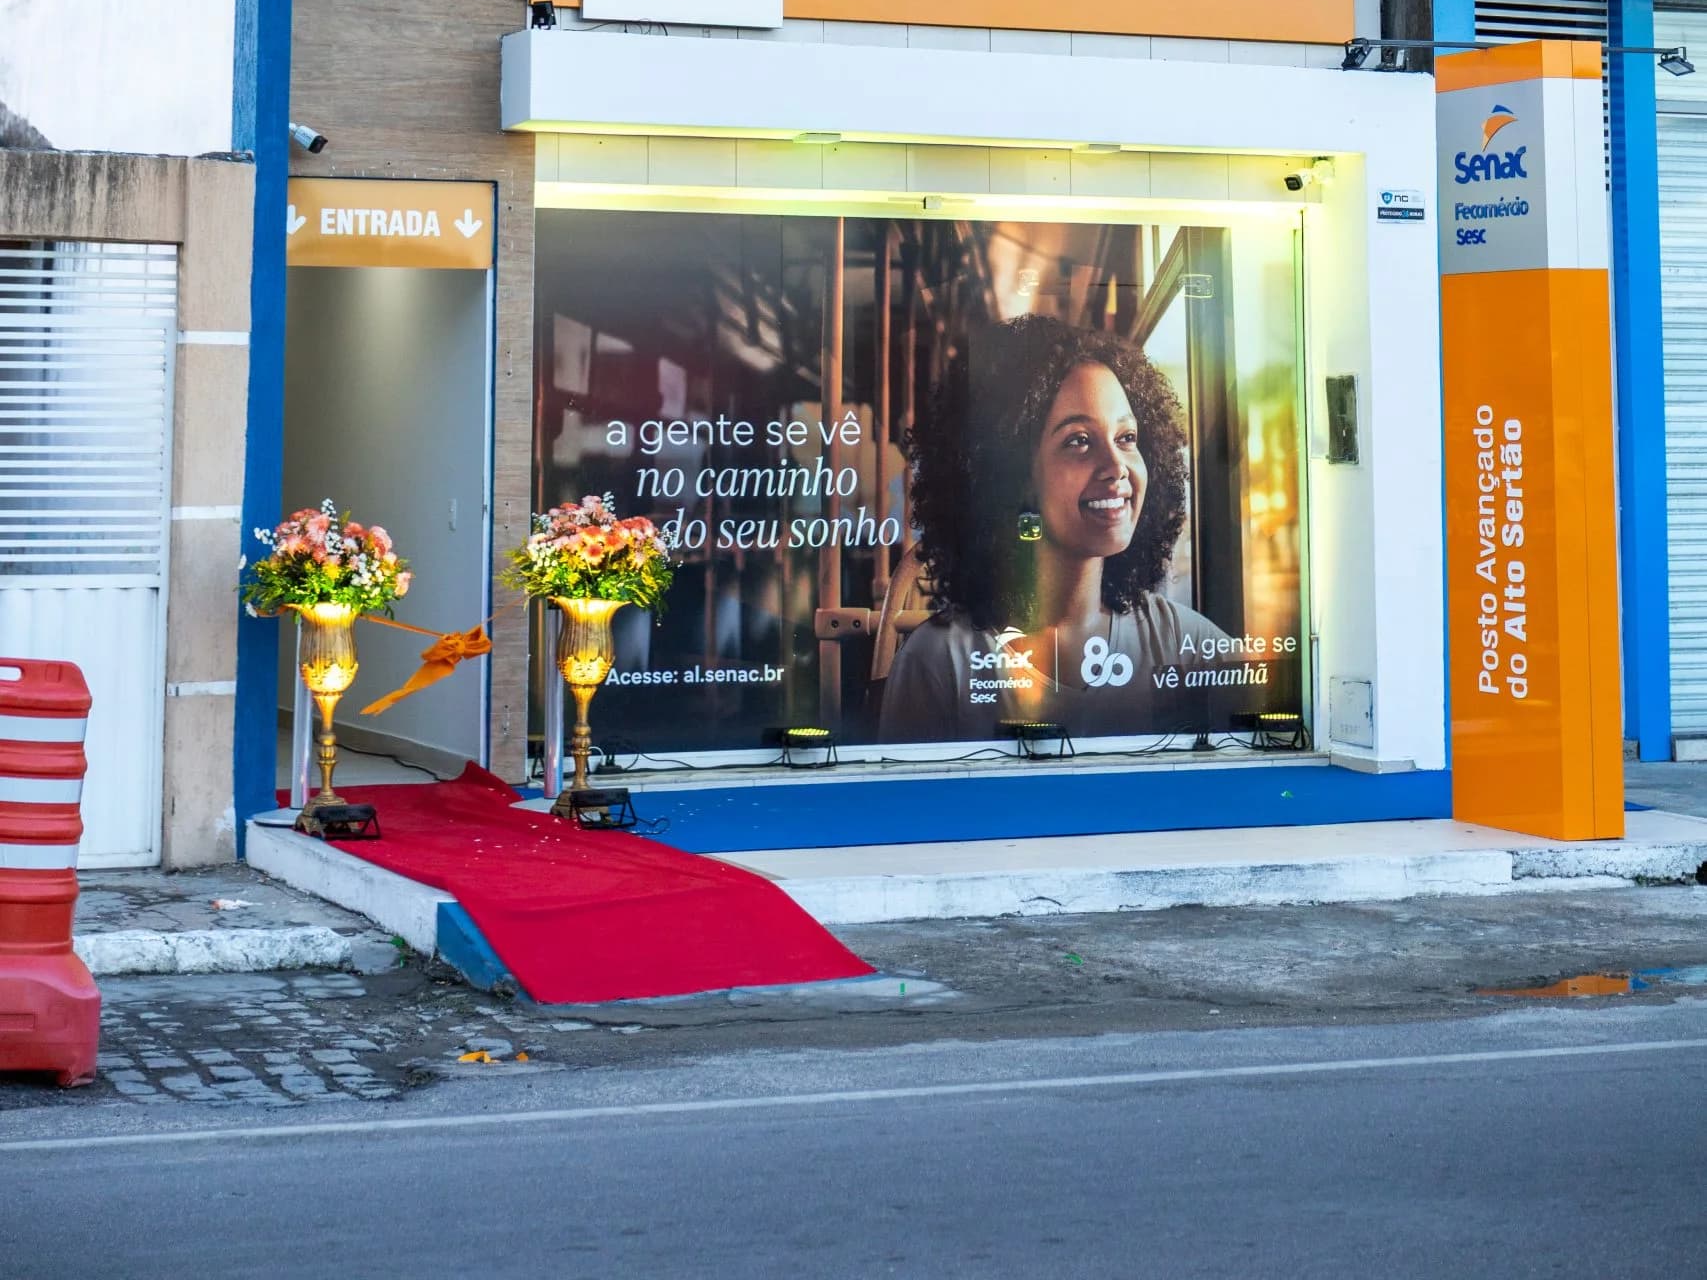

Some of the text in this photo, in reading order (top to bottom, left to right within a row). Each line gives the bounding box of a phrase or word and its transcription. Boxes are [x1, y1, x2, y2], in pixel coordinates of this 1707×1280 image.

[1454, 145, 1528, 185] Senac
[320, 207, 441, 237] ENTRADA
[1454, 196, 1529, 221] Fecomércio
[1456, 227, 1487, 246] Sesc
[605, 410, 861, 455] a gente se vê
[636, 456, 858, 497] no caminho
[661, 506, 900, 549] do seu sonho
[1472, 404, 1500, 694] Posto Avançado
[1500, 418, 1529, 699] do Alto Sertão
[970, 649, 1033, 670] Senac
[1179, 633, 1297, 659] A gente se
[605, 664, 785, 686] Acesse: al.senac.br
[1080, 635, 1134, 687] 80
[969, 676, 1034, 690] Fecomércio
[1152, 662, 1268, 689] vê amanhã
[969, 692, 998, 704] Sesc
